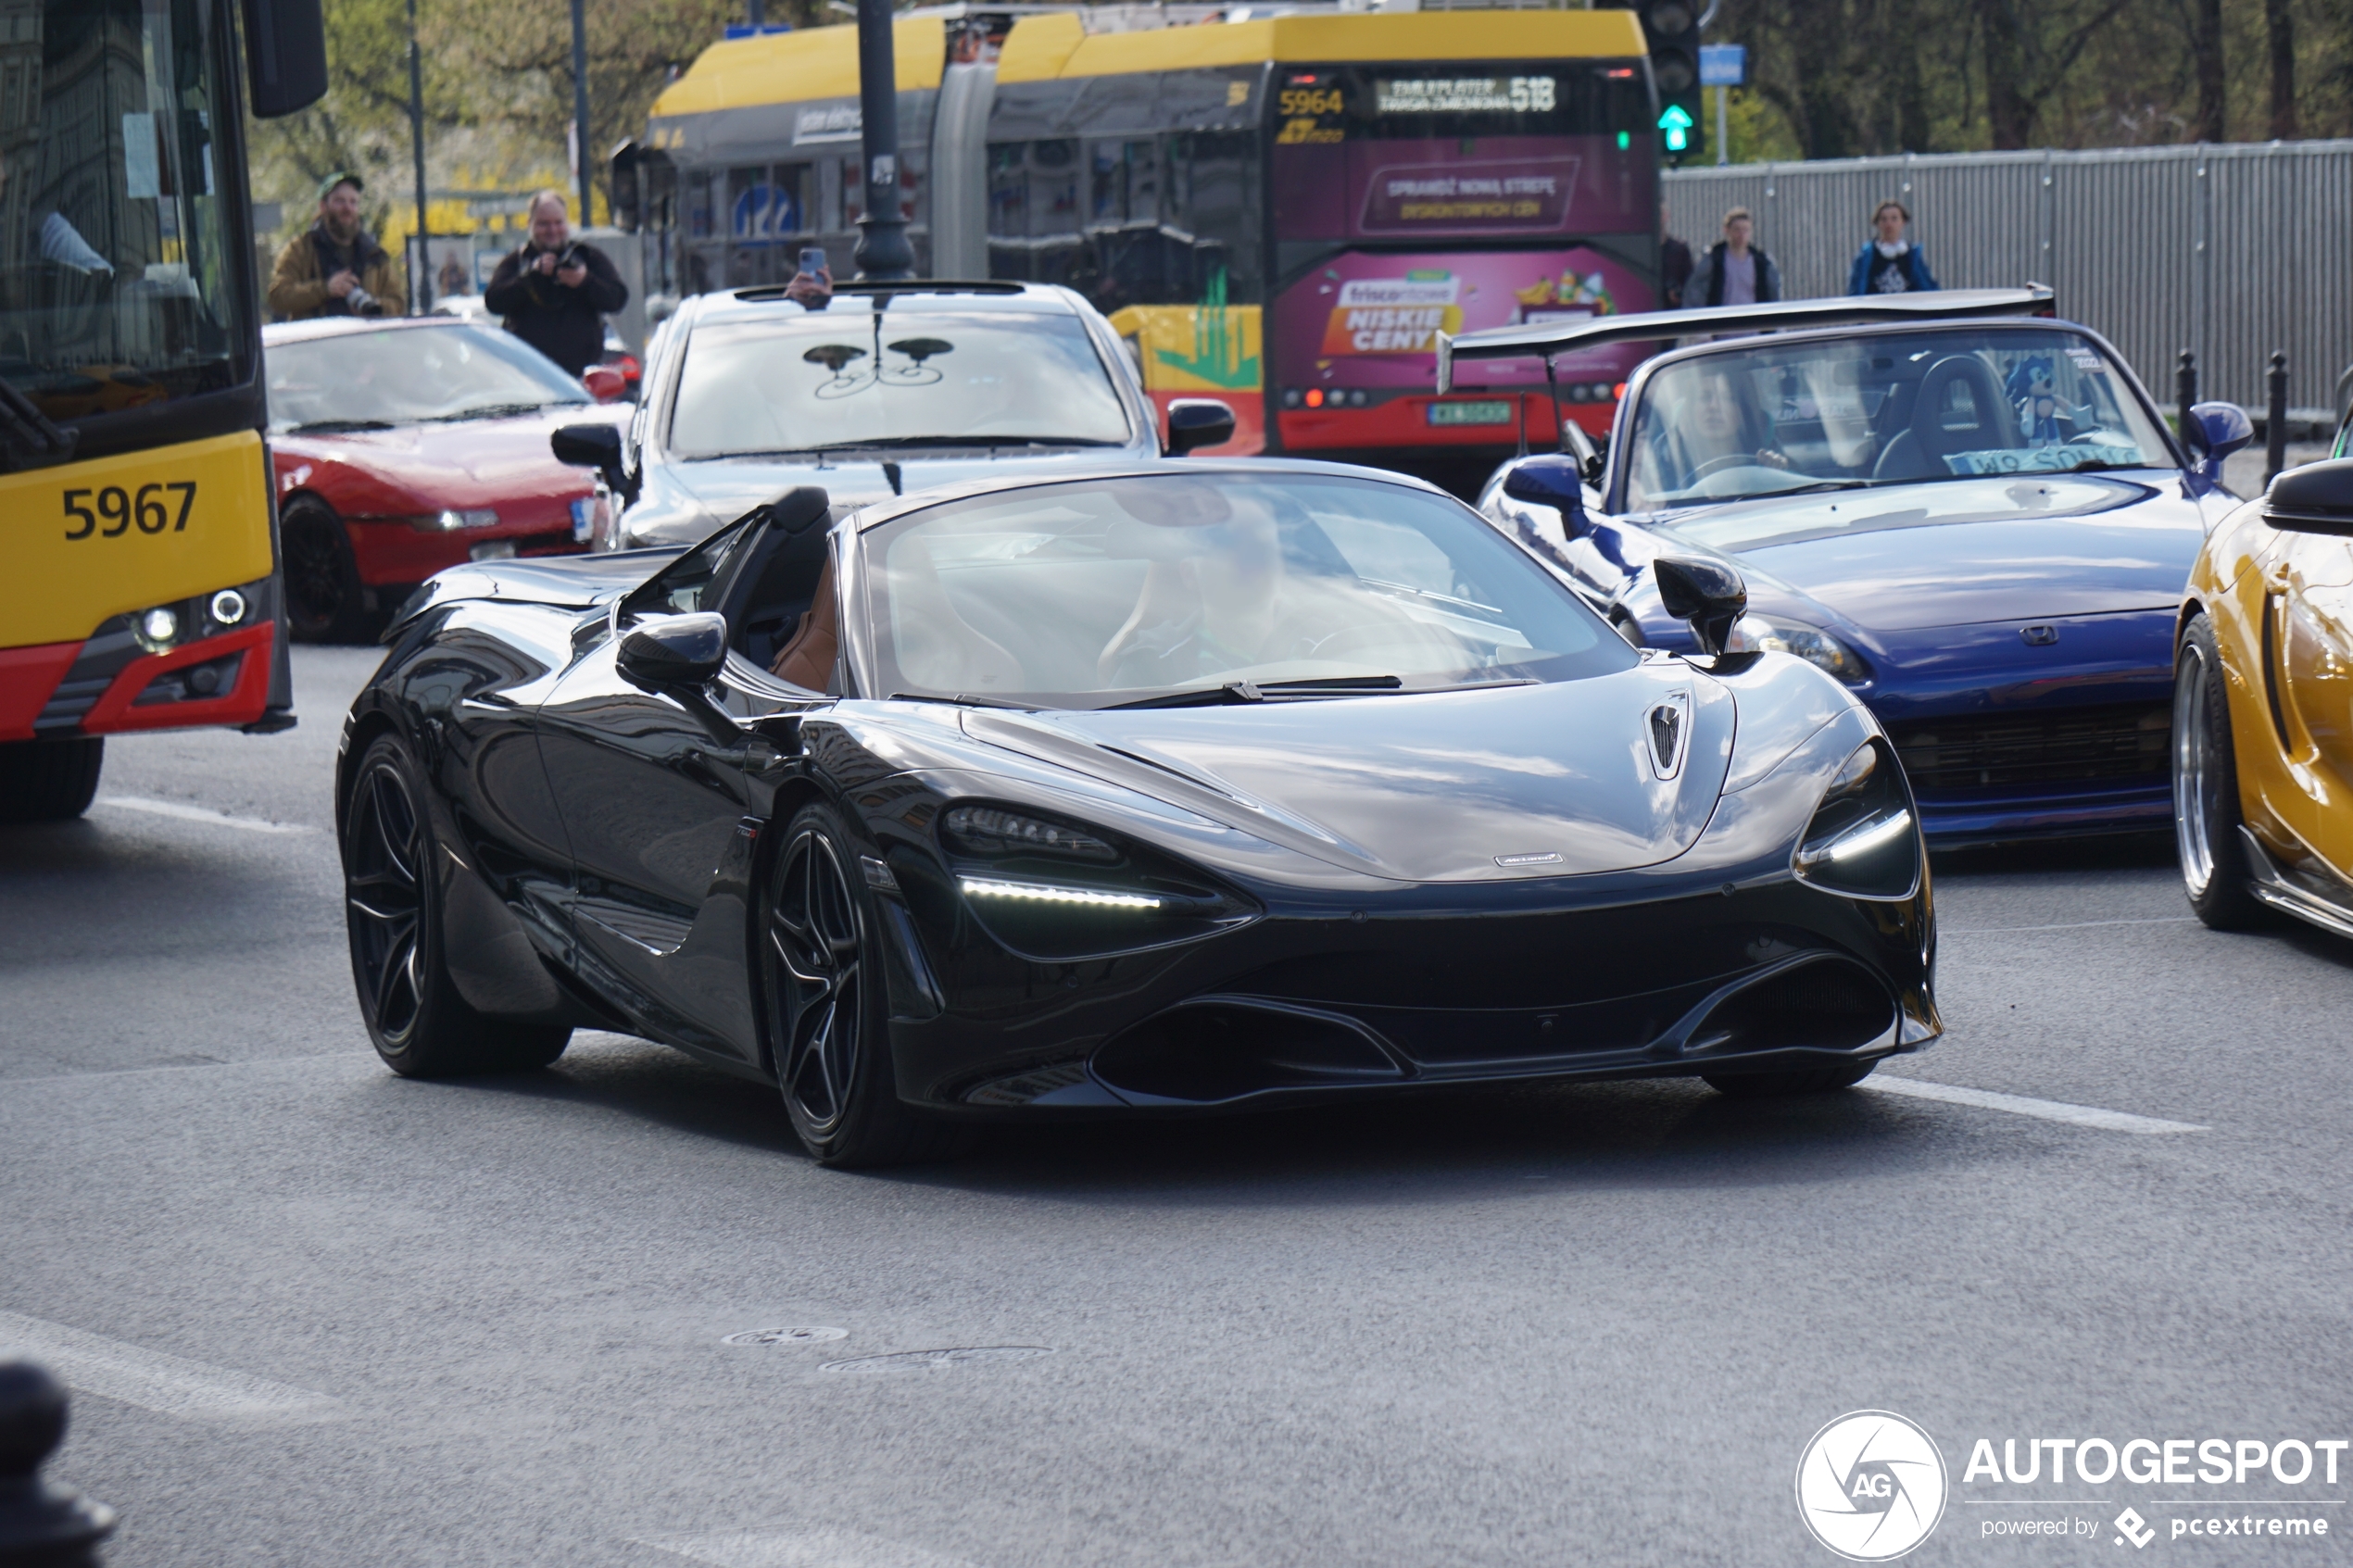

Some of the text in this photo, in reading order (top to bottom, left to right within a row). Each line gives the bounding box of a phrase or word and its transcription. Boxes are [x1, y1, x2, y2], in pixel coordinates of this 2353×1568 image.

[1280, 89, 1342, 115] 5964
[1510, 77, 1555, 112] 518
[1346, 308, 1443, 331] NISKIE
[1353, 329, 1432, 351] CENY
[63, 481, 197, 541] 5967
